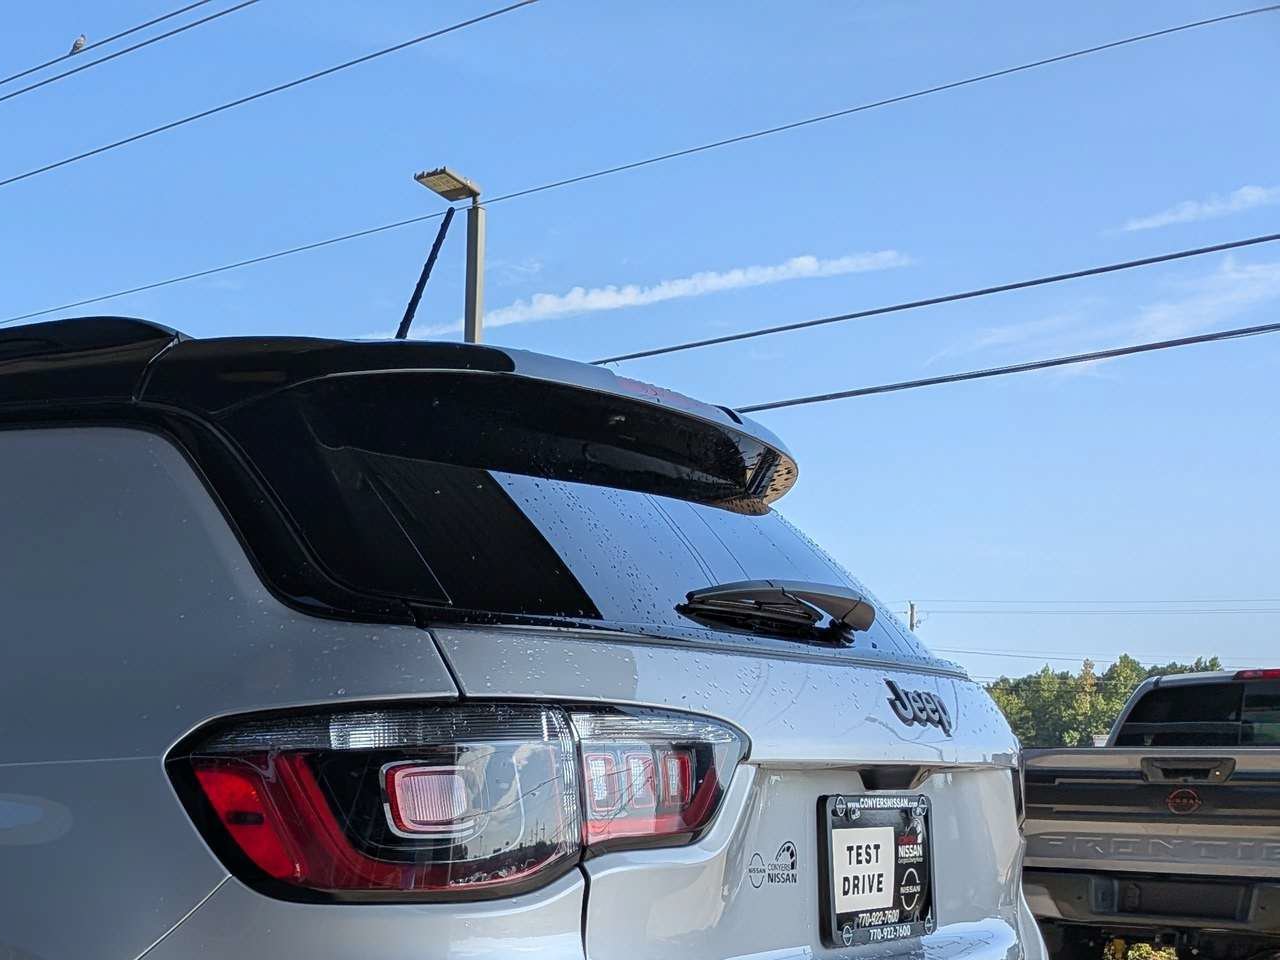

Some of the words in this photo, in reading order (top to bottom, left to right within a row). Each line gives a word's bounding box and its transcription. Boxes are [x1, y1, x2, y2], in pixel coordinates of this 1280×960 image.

[882, 677, 953, 737] Jeep
[846, 844, 881, 865] TEST
[898, 844, 923, 858] NISSAN
[767, 872, 798, 884] NISSAN
[842, 872, 884, 896] DRIVE
[900, 885, 921, 894] NISSAN
[858, 910, 900, 926] 770-922-7600
[870, 925, 911, 940] 770-922-7600
